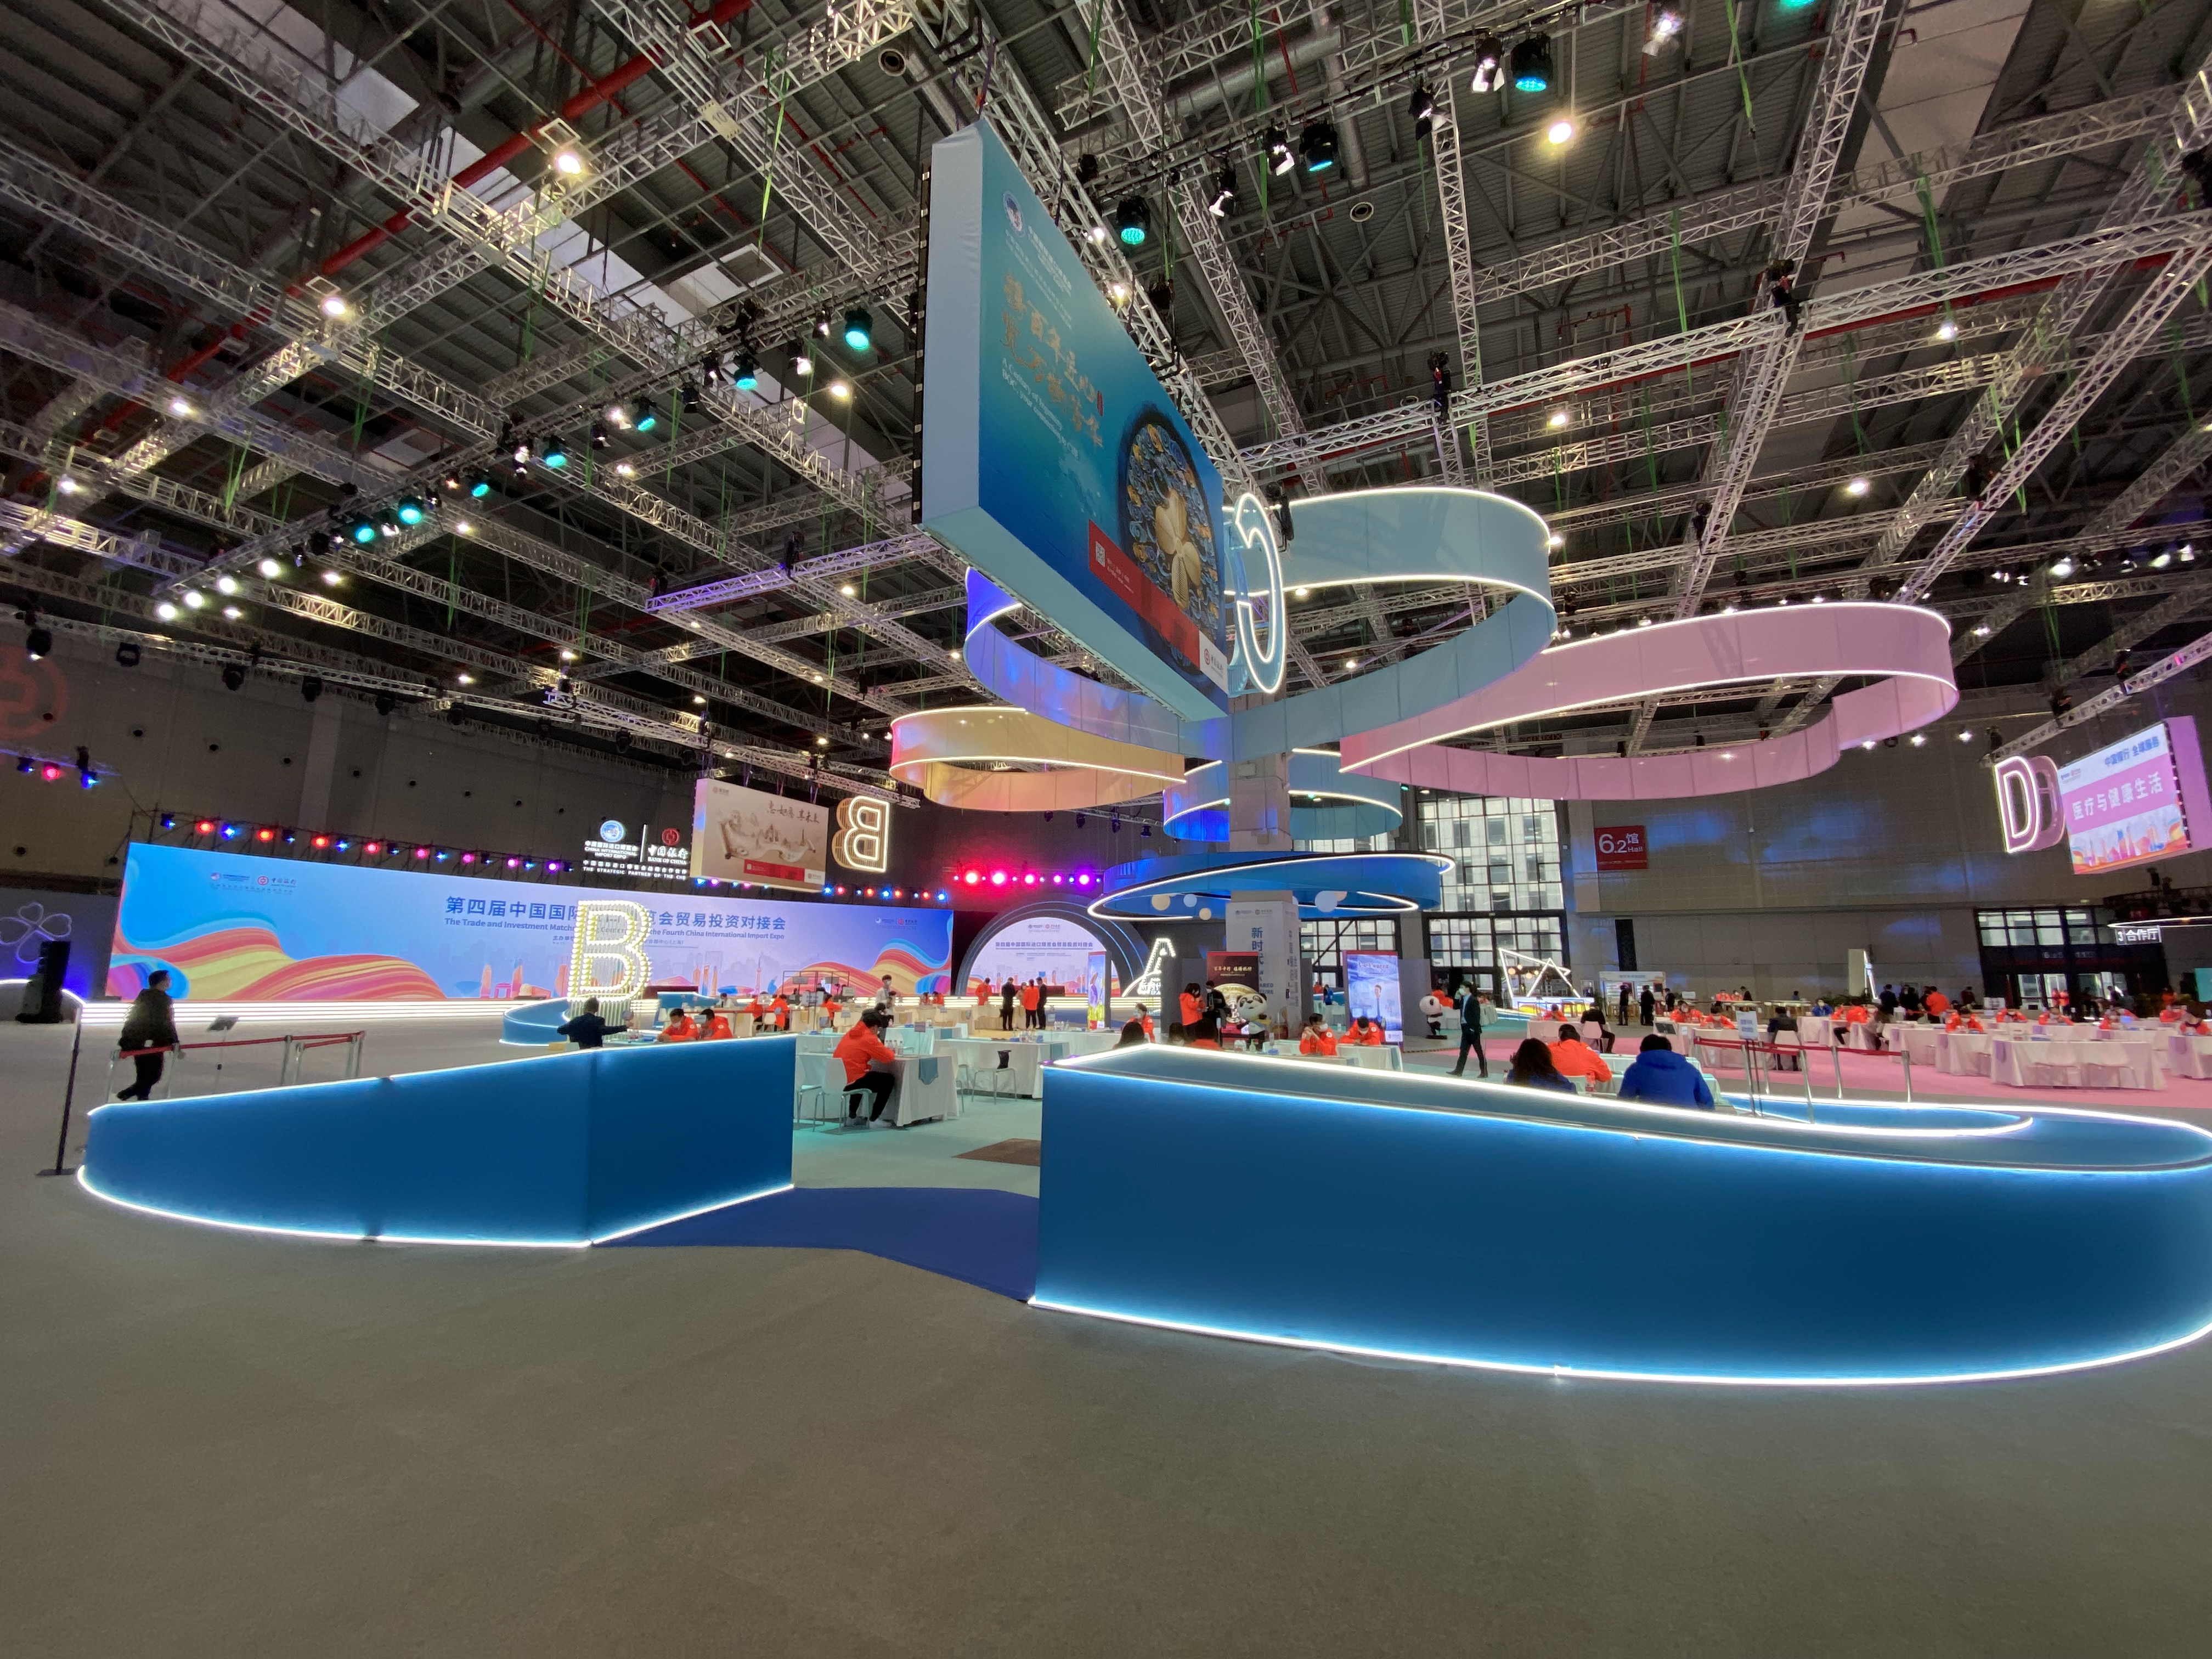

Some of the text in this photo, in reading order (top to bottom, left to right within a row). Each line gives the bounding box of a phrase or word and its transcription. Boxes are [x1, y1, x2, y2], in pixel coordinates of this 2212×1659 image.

[2072, 771, 2163, 820] 医疗与健康生活
[1994, 755, 2044, 853] D
[601, 848, 638, 857] INTERNATIONAL
[648, 844, 688, 860] 中国银行
[444, 917, 460, 926] The
[462, 918, 486, 927] Trade
[504, 921, 548, 930] Investment
[2125, 928, 2159, 941] 合作厅
[567, 899, 651, 1000] B
